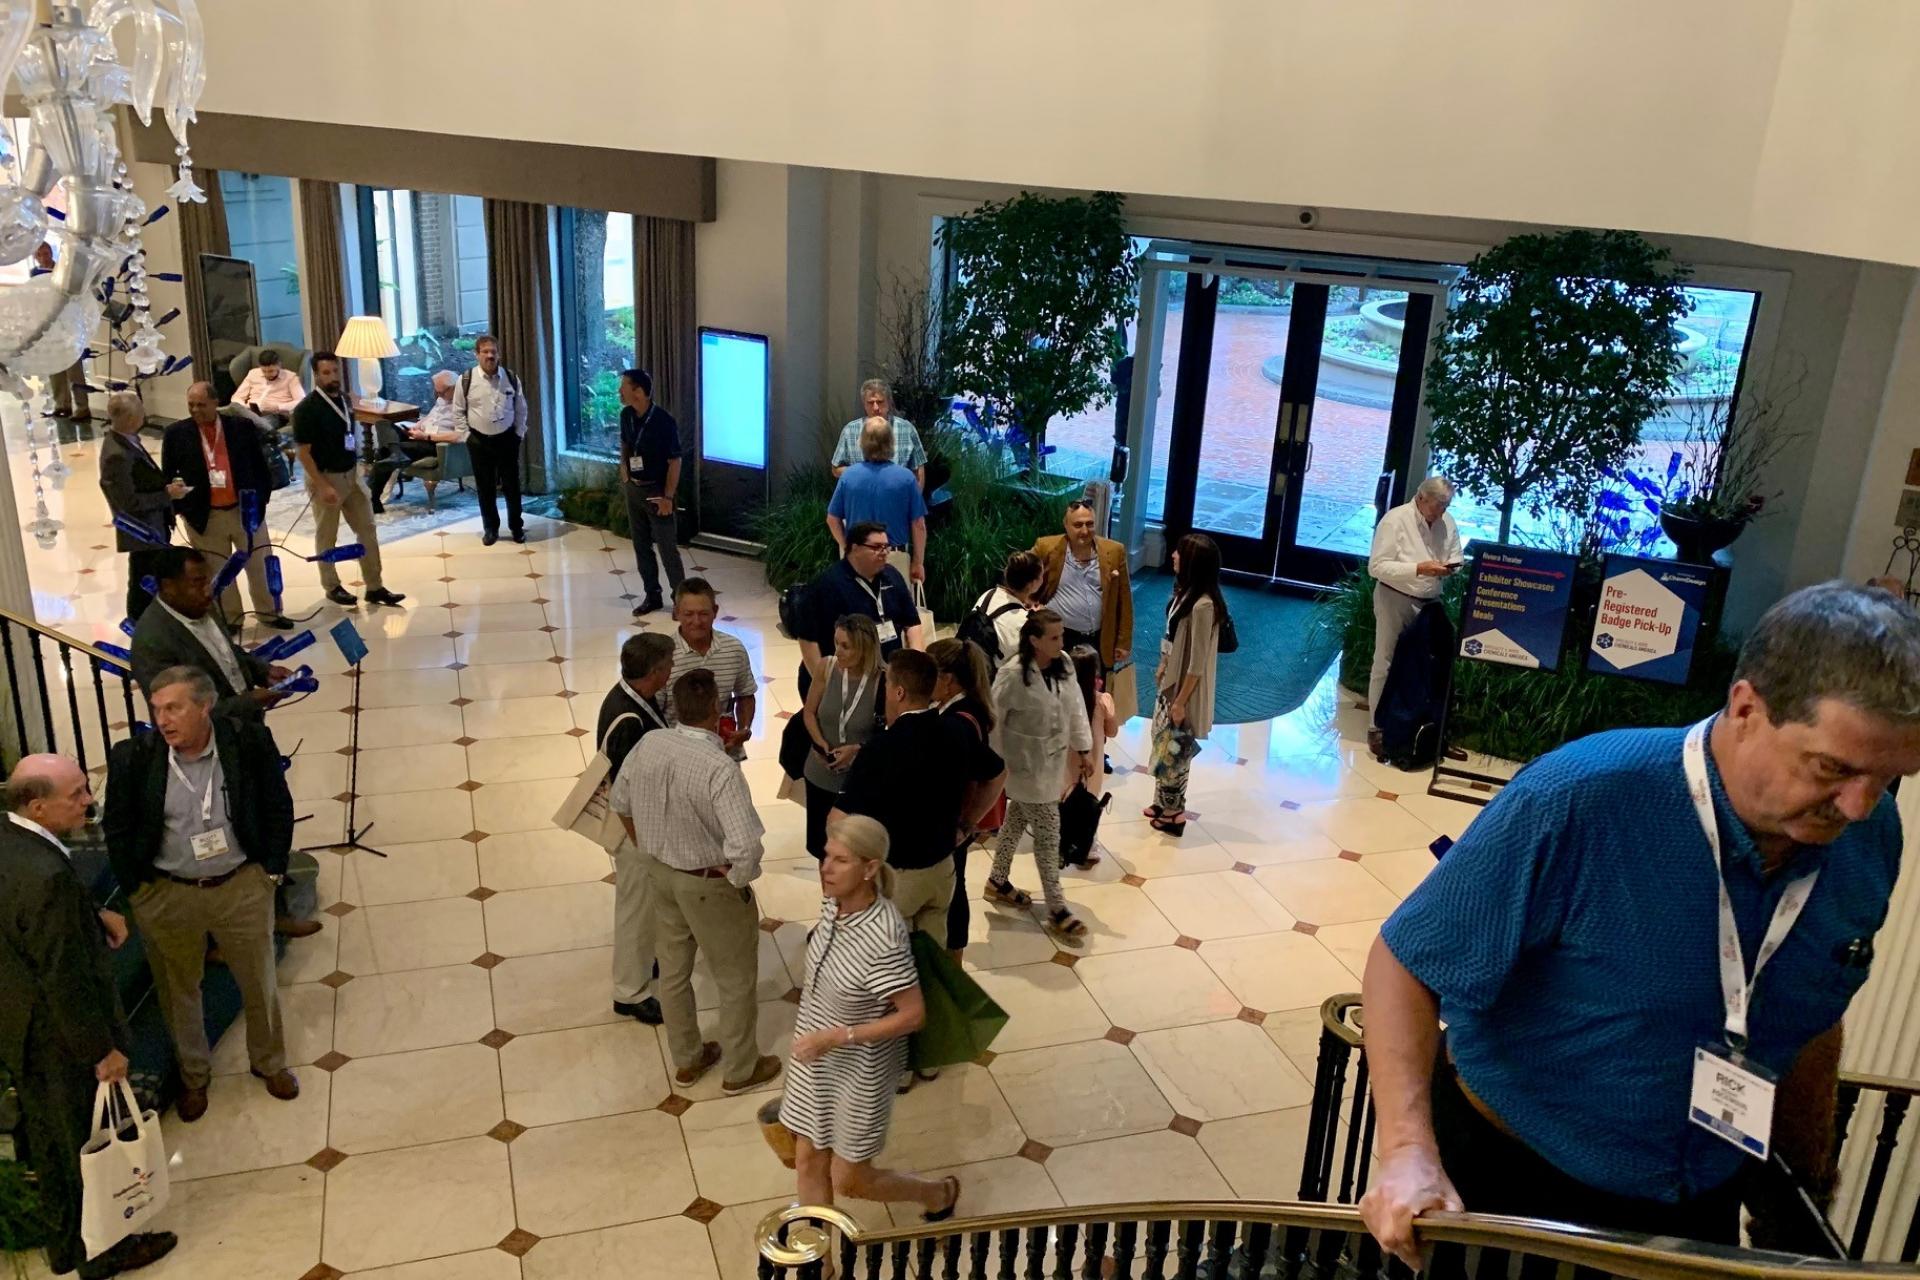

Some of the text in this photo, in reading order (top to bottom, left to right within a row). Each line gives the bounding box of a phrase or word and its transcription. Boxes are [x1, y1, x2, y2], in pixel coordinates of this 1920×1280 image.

[1479, 572, 1555, 592] Exhibitor Showcases
[1476, 586, 1519, 600] Conference
[1606, 585, 1627, 598] Pre-
[1474, 596, 1526, 612] Presentations
[1603, 599, 1658, 618] Registered
[1472, 609, 1495, 621] Meals
[1600, 613, 1672, 636] Badge Pick-Up
